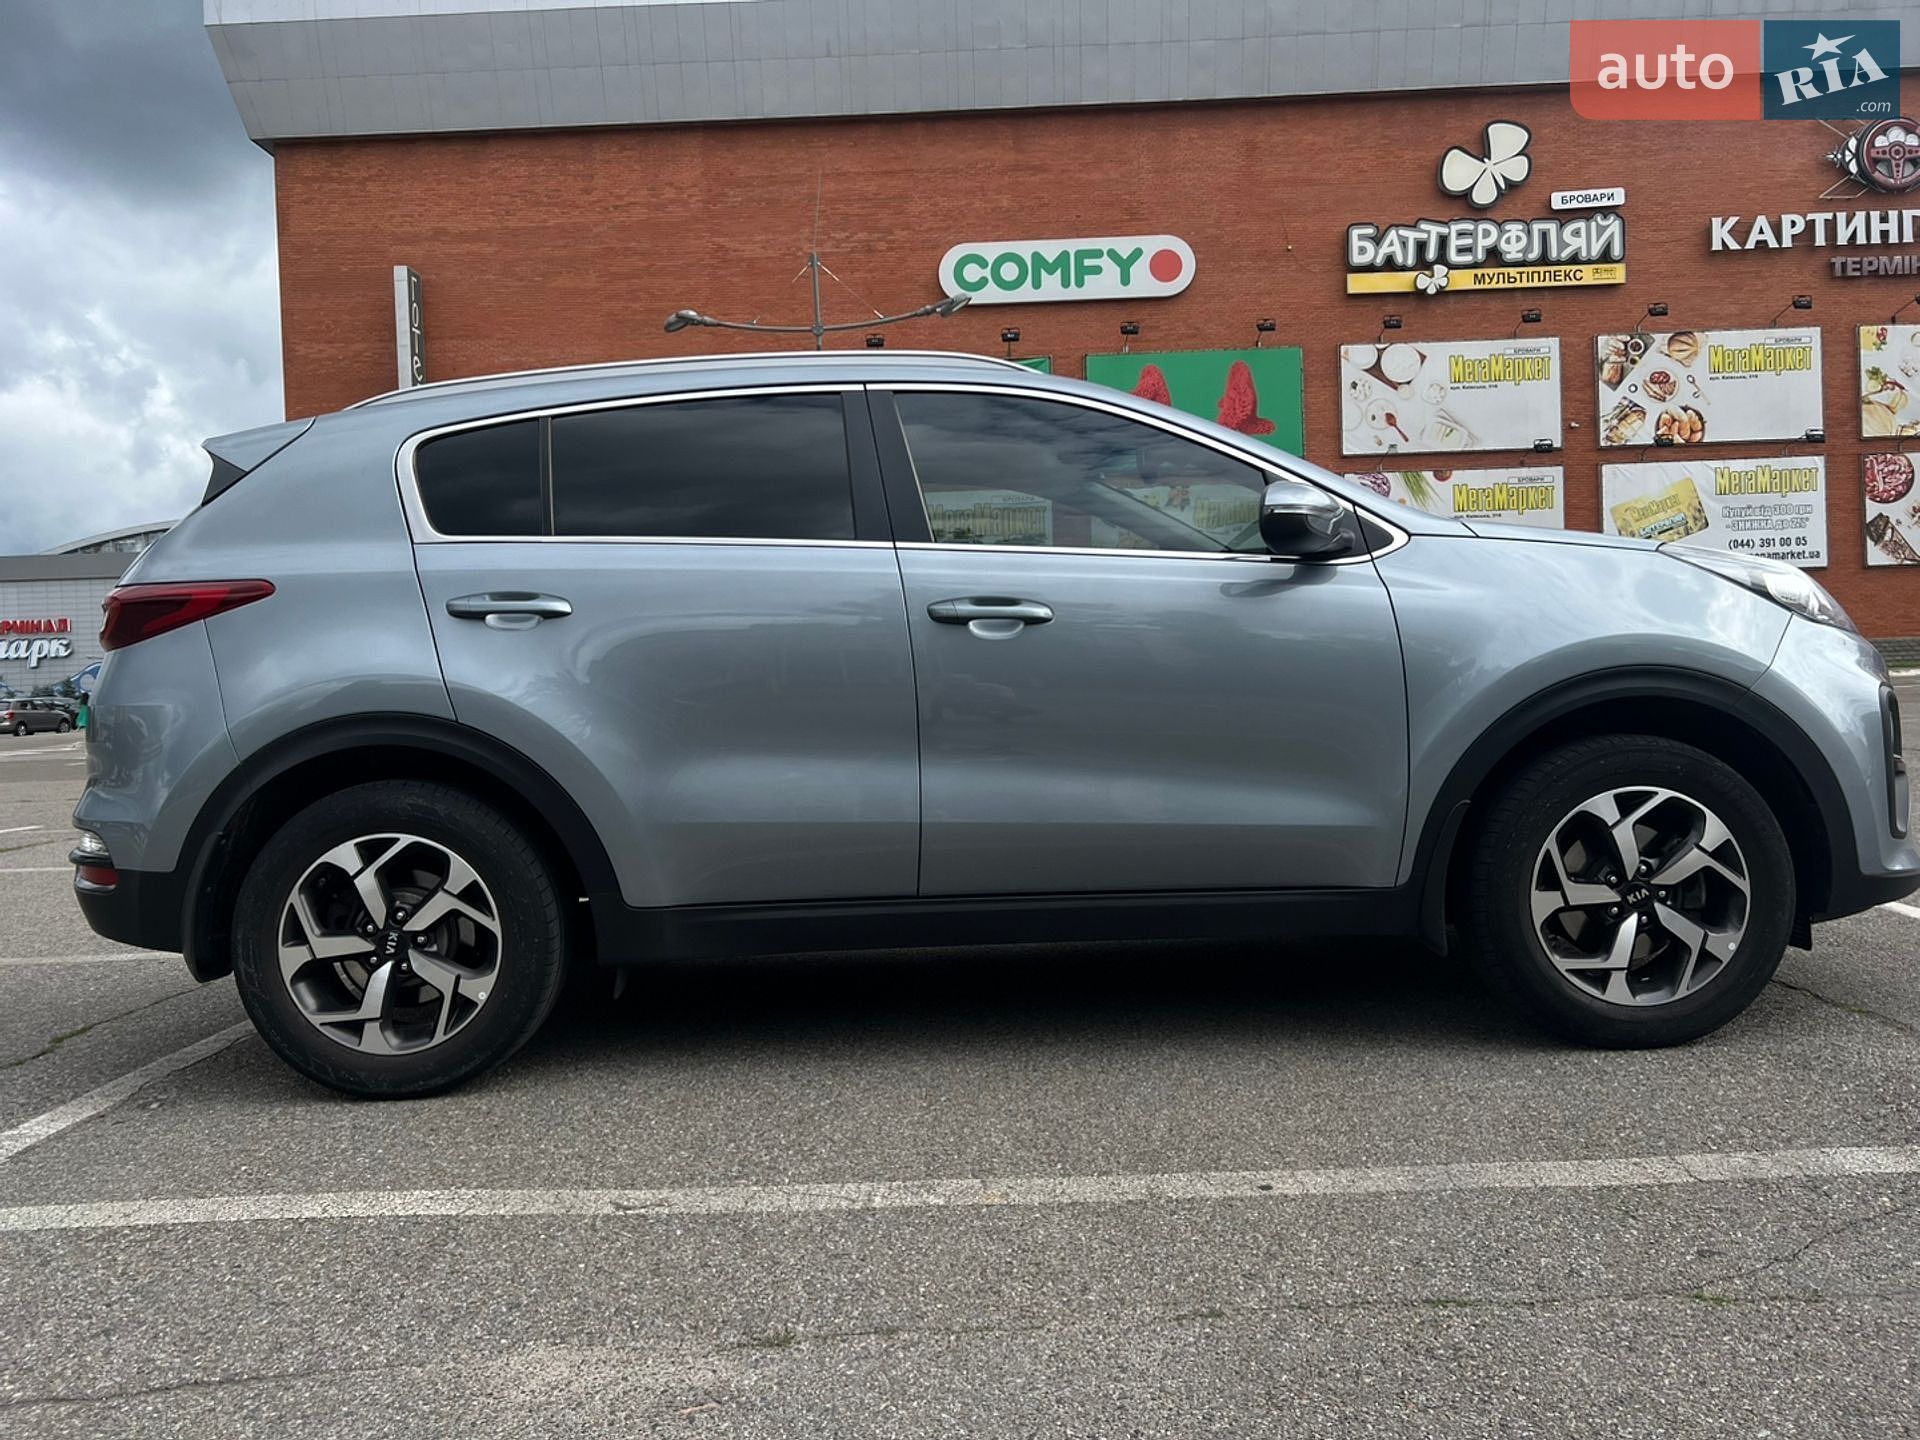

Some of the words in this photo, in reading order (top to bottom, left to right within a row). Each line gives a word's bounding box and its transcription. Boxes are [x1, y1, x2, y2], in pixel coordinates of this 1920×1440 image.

[1560, 192, 1615, 206] БРОВАРИ
[1349, 214, 1624, 267] БАТТЕРФЛЯЙ
[1711, 209, 1920, 251] КАРТИНГ
[953, 246, 1143, 292] COMFY
[1473, 269, 1584, 286] МУЛЬТІПЛЕКС
[1449, 353, 1551, 386] МегаМаркет
[1709, 343, 1812, 376] МегаМаркет
[1714, 465, 1818, 497] МегаМаркет
[1453, 482, 1554, 515] МегаМаркет
[1728, 538, 1755, 550] (044)
[1759, 538, 1776, 548] 391
[1779, 537, 1792, 547] 00
[1795, 536, 1808, 546] 05
[1626, 888, 1650, 904] KIA
[385, 931, 398, 954] KIA
